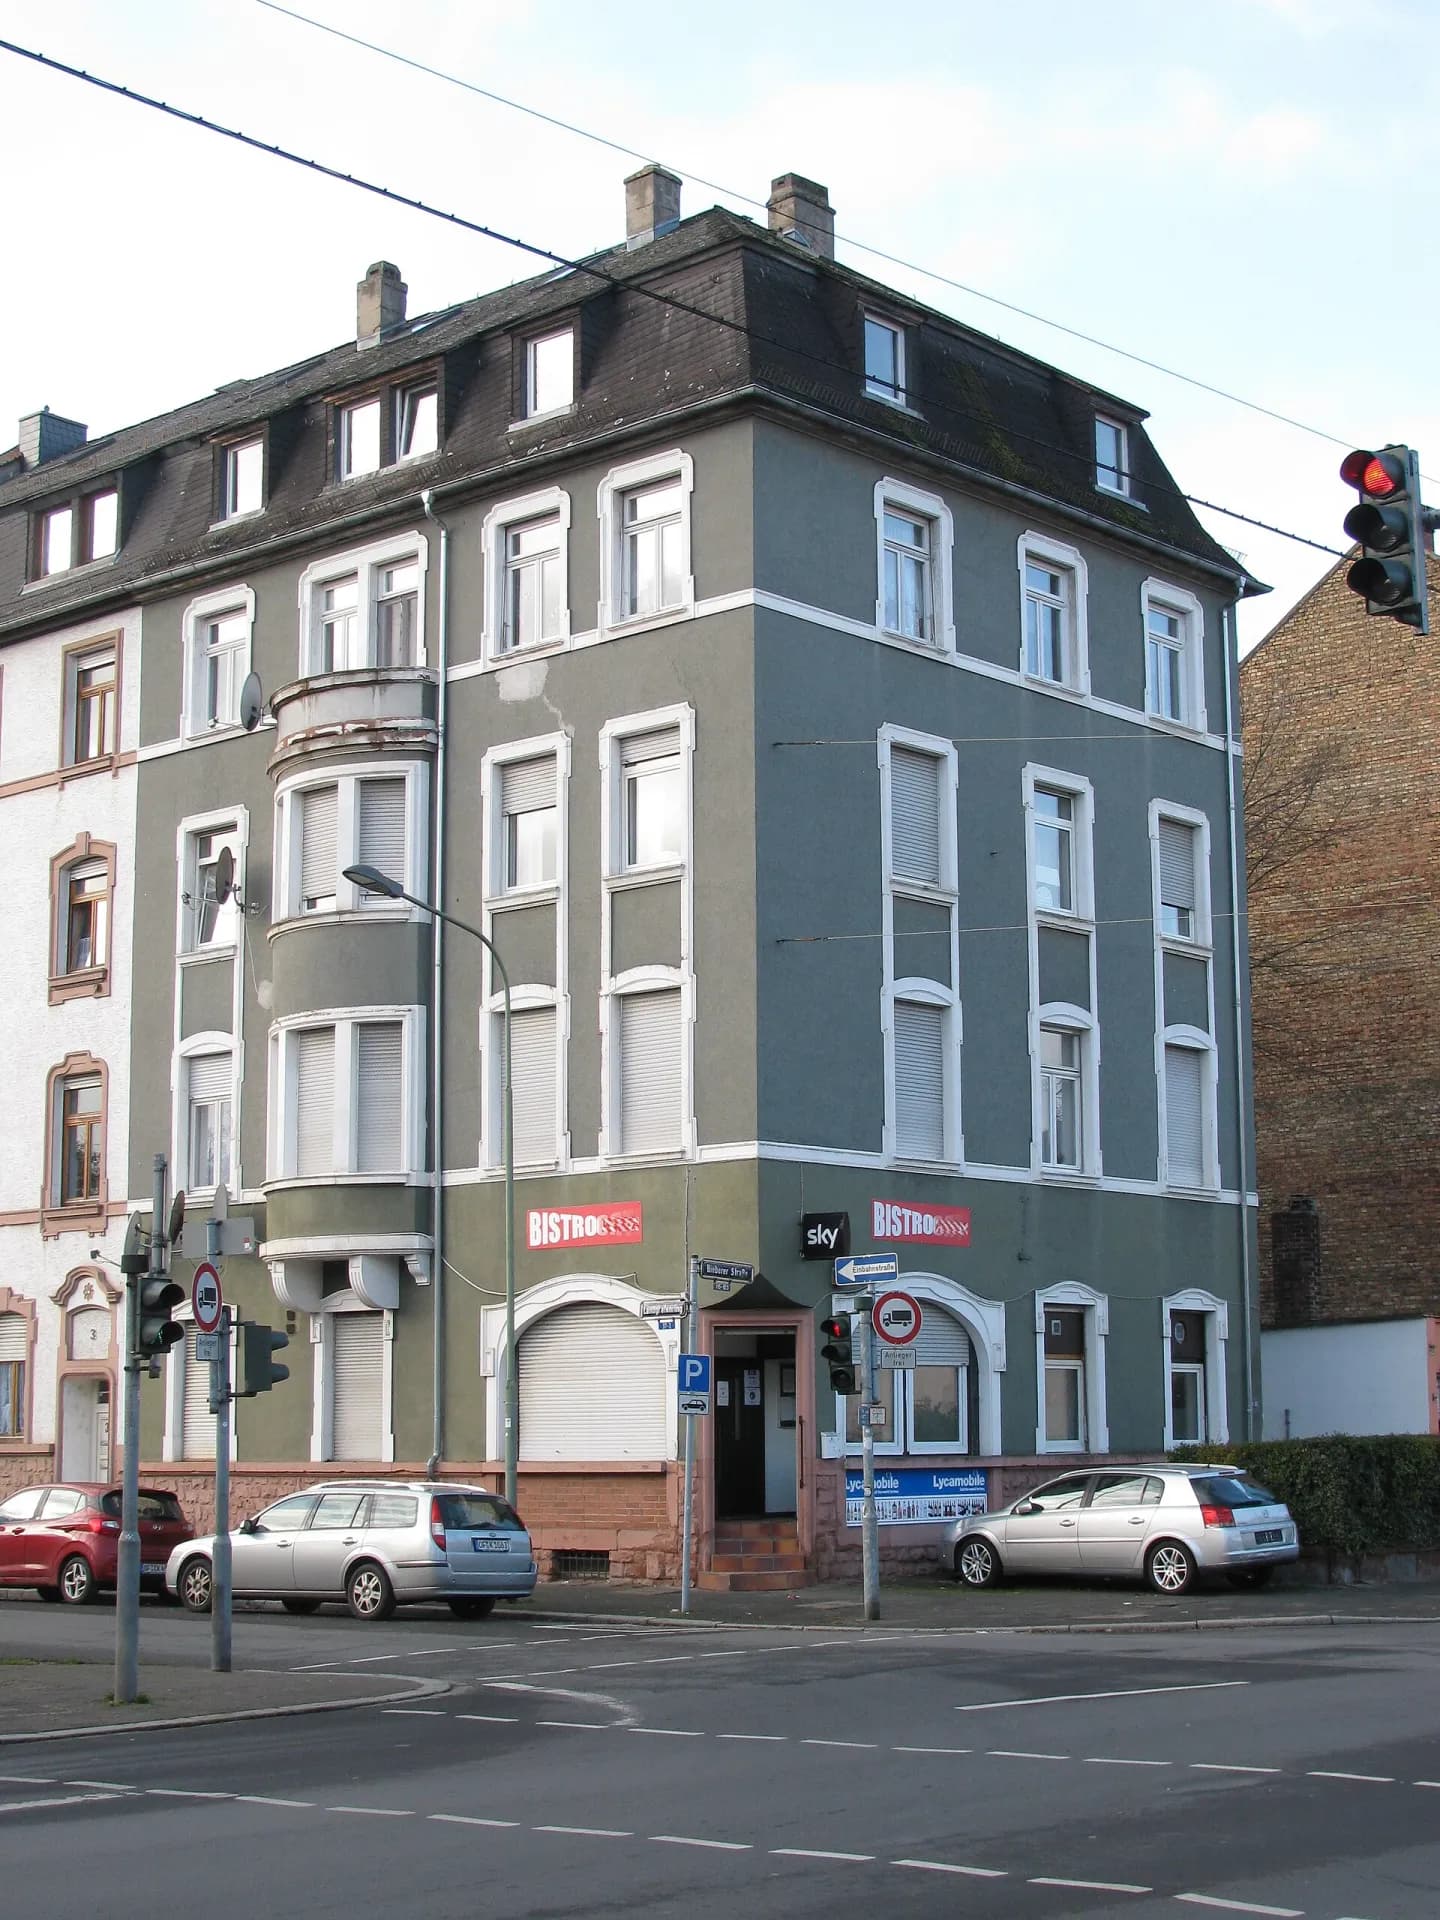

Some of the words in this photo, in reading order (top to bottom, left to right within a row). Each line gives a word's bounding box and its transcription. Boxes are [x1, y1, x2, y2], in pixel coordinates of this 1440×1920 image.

[873, 1201, 934, 1237] BISTRO
[529, 1211, 597, 1247] BISTRO
[807, 1223, 839, 1249] sky
[852, 1263, 894, 1274] Einbahnstraße
[90, 1329, 97, 1341] 3
[884, 1351, 913, 1360] Anlieger
[685, 1359, 703, 1388] P
[845, 1475, 899, 1493] Lycobile
[933, 1473, 985, 1490] Lycamobile
